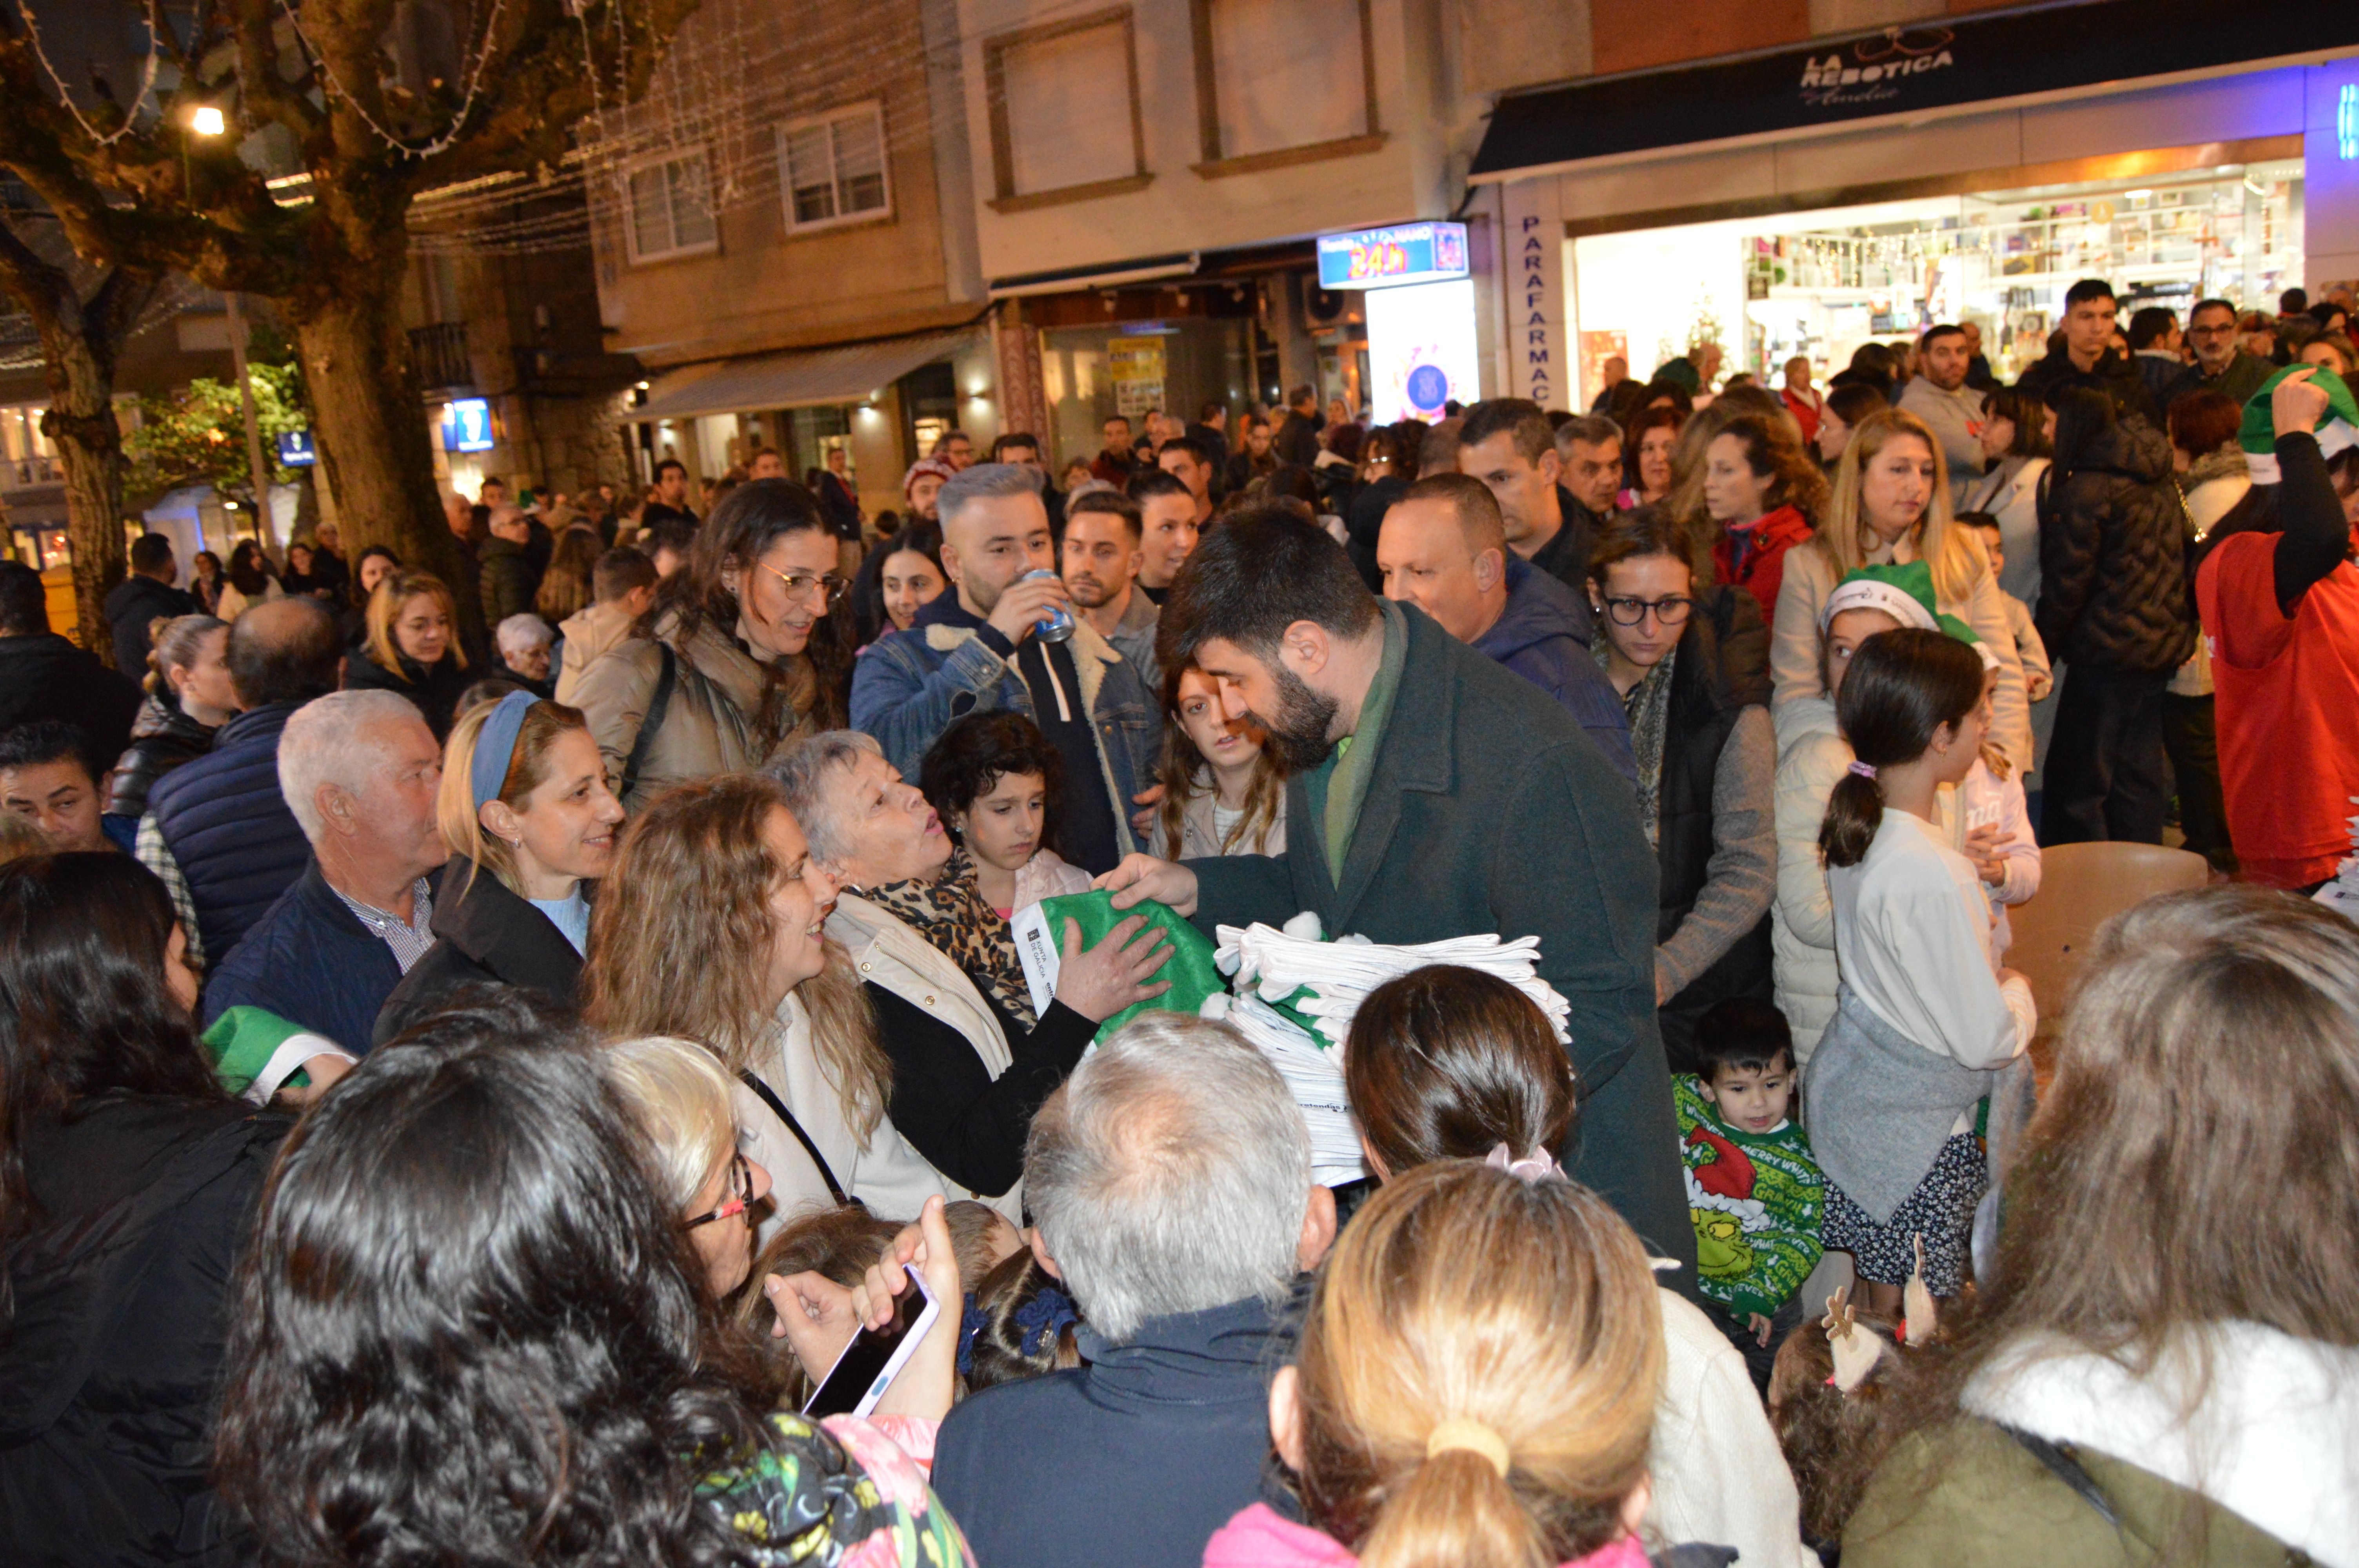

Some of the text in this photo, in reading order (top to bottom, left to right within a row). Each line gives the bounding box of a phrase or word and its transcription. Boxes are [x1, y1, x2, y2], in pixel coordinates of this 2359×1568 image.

[1801, 50, 1953, 88] REBOTICA
[1806, 54, 1842, 71] LA
[1030, 942, 1046, 978] DE GALICIA
[1036, 940, 1047, 962] XUNTA
[1739, 1144, 1782, 1165] MERRY
